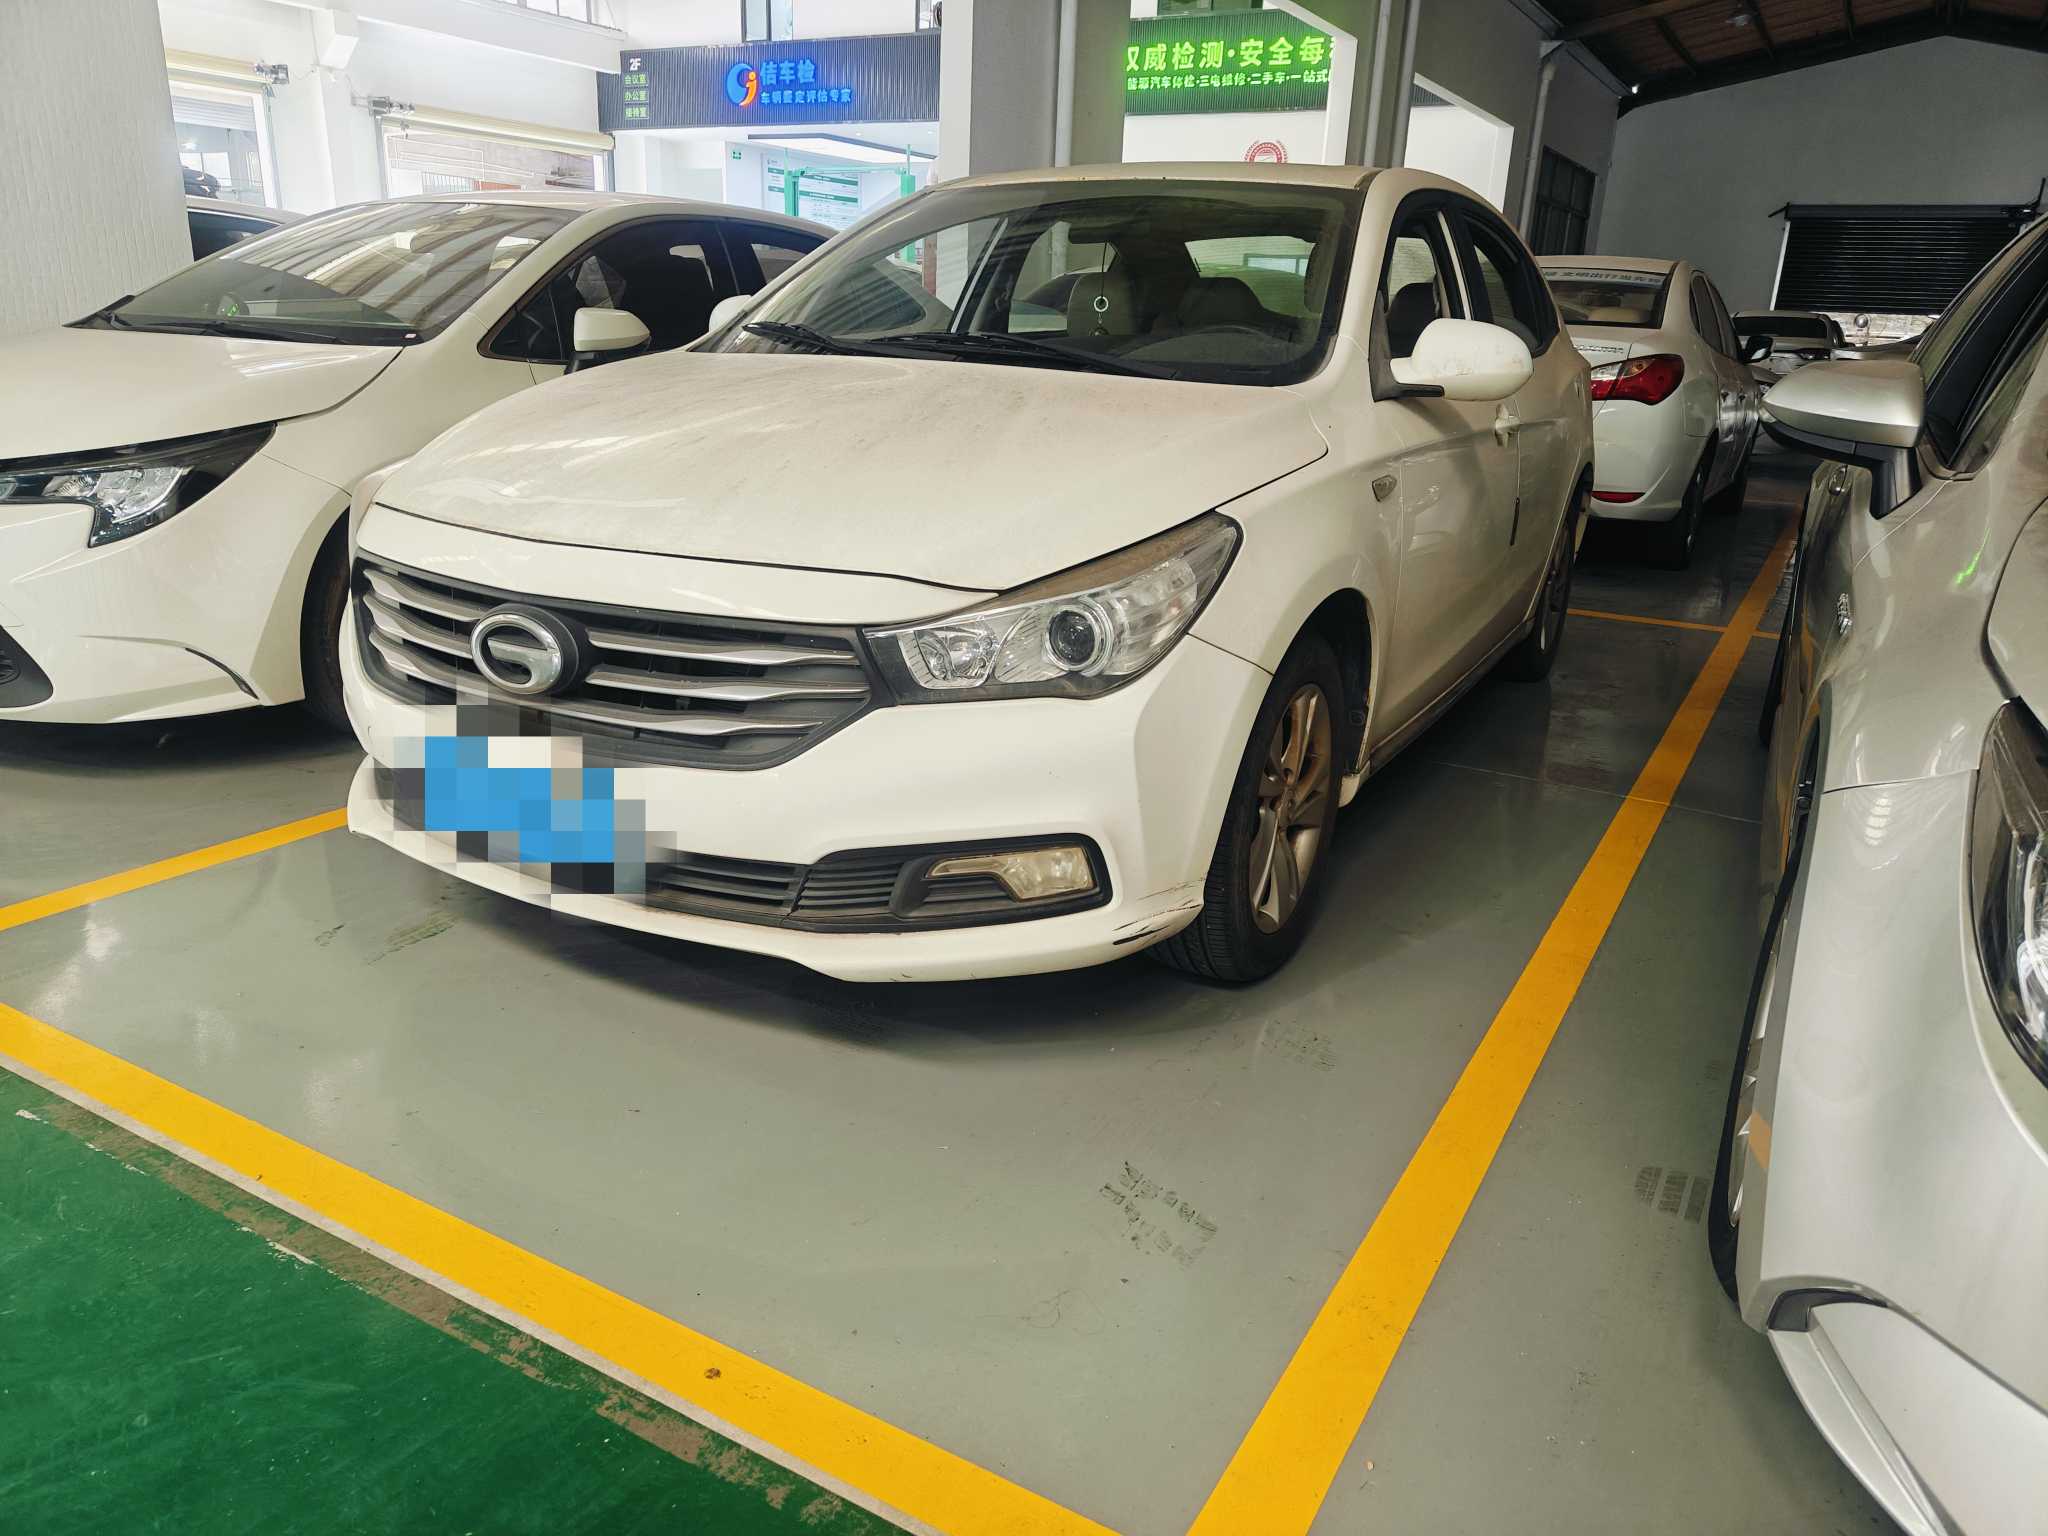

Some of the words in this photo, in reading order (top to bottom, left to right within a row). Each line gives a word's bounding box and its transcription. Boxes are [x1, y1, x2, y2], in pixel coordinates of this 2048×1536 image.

[1126, 36, 1335, 72] 权威检测·安全每
[629, 57, 641, 71] 2F
[624, 74, 647, 85] 会议室
[624, 90, 647, 101] 办公室
